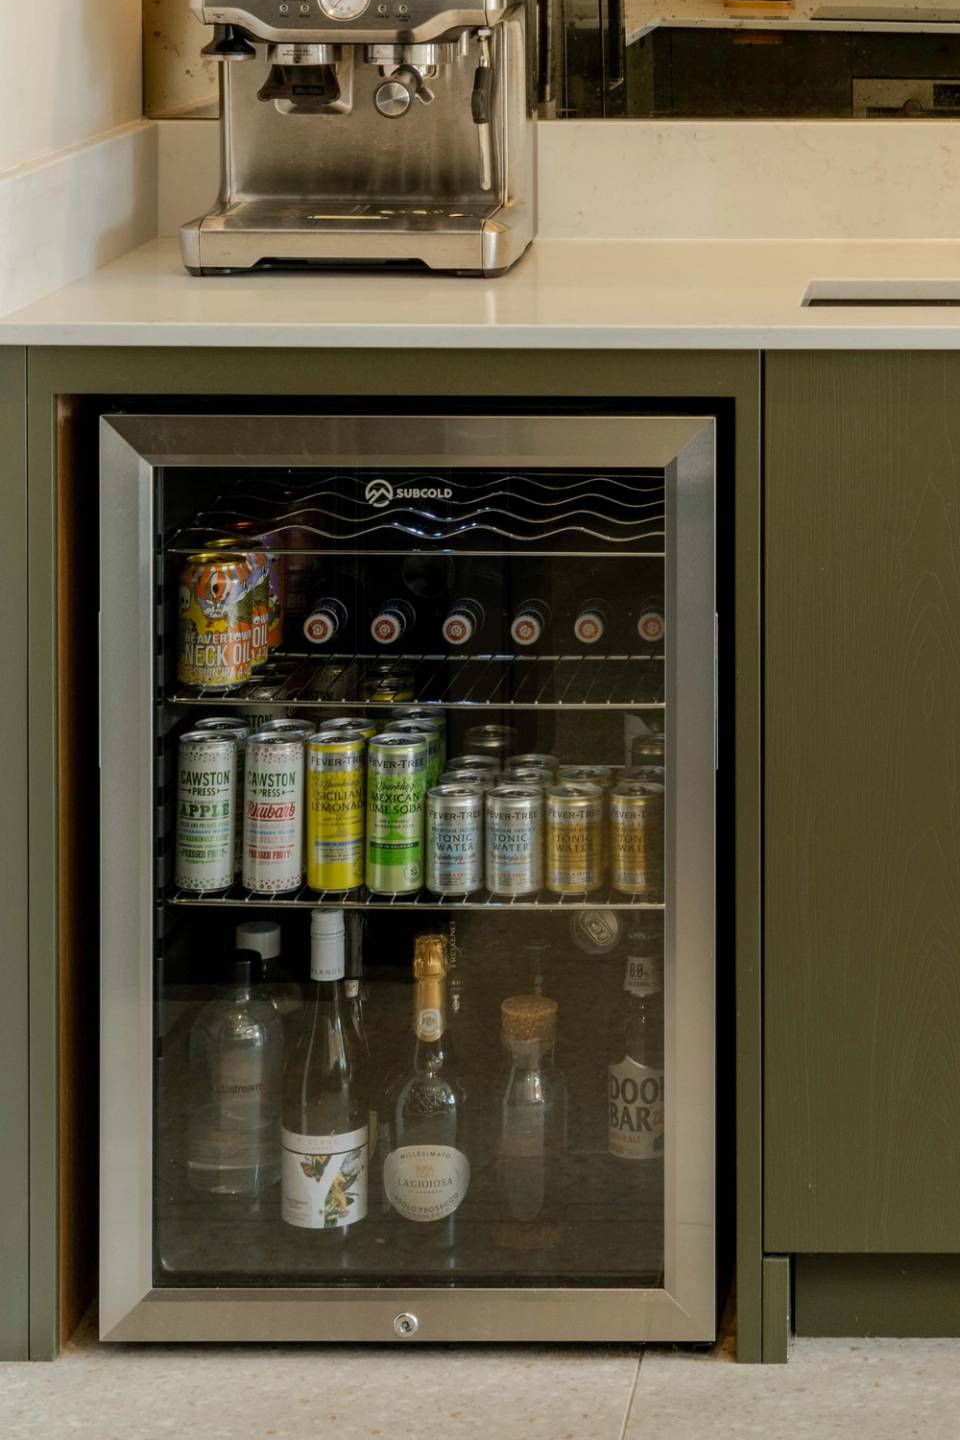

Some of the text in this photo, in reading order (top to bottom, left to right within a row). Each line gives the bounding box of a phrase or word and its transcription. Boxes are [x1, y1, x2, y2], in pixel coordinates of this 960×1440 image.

[396, 488, 453, 498] SUBCOLD
[184, 642, 250, 666] NECK OIL
[181, 770, 230, 787] CAWSTON
[192, 787, 216, 796] PRESS
[372, 793, 420, 804] MEXICAN
[181, 802, 229, 818] APPLE
[391, 804, 422, 815] SODA
[437, 833, 473, 842] TONIC
[493, 833, 528, 842] TONIC
[436, 843, 474, 851] WATER
[493, 842, 529, 851] WATER
[610, 1073, 664, 1105] DOO
[610, 1105, 652, 1132] BAR
[419, 1192, 459, 1213] PROSECCO
